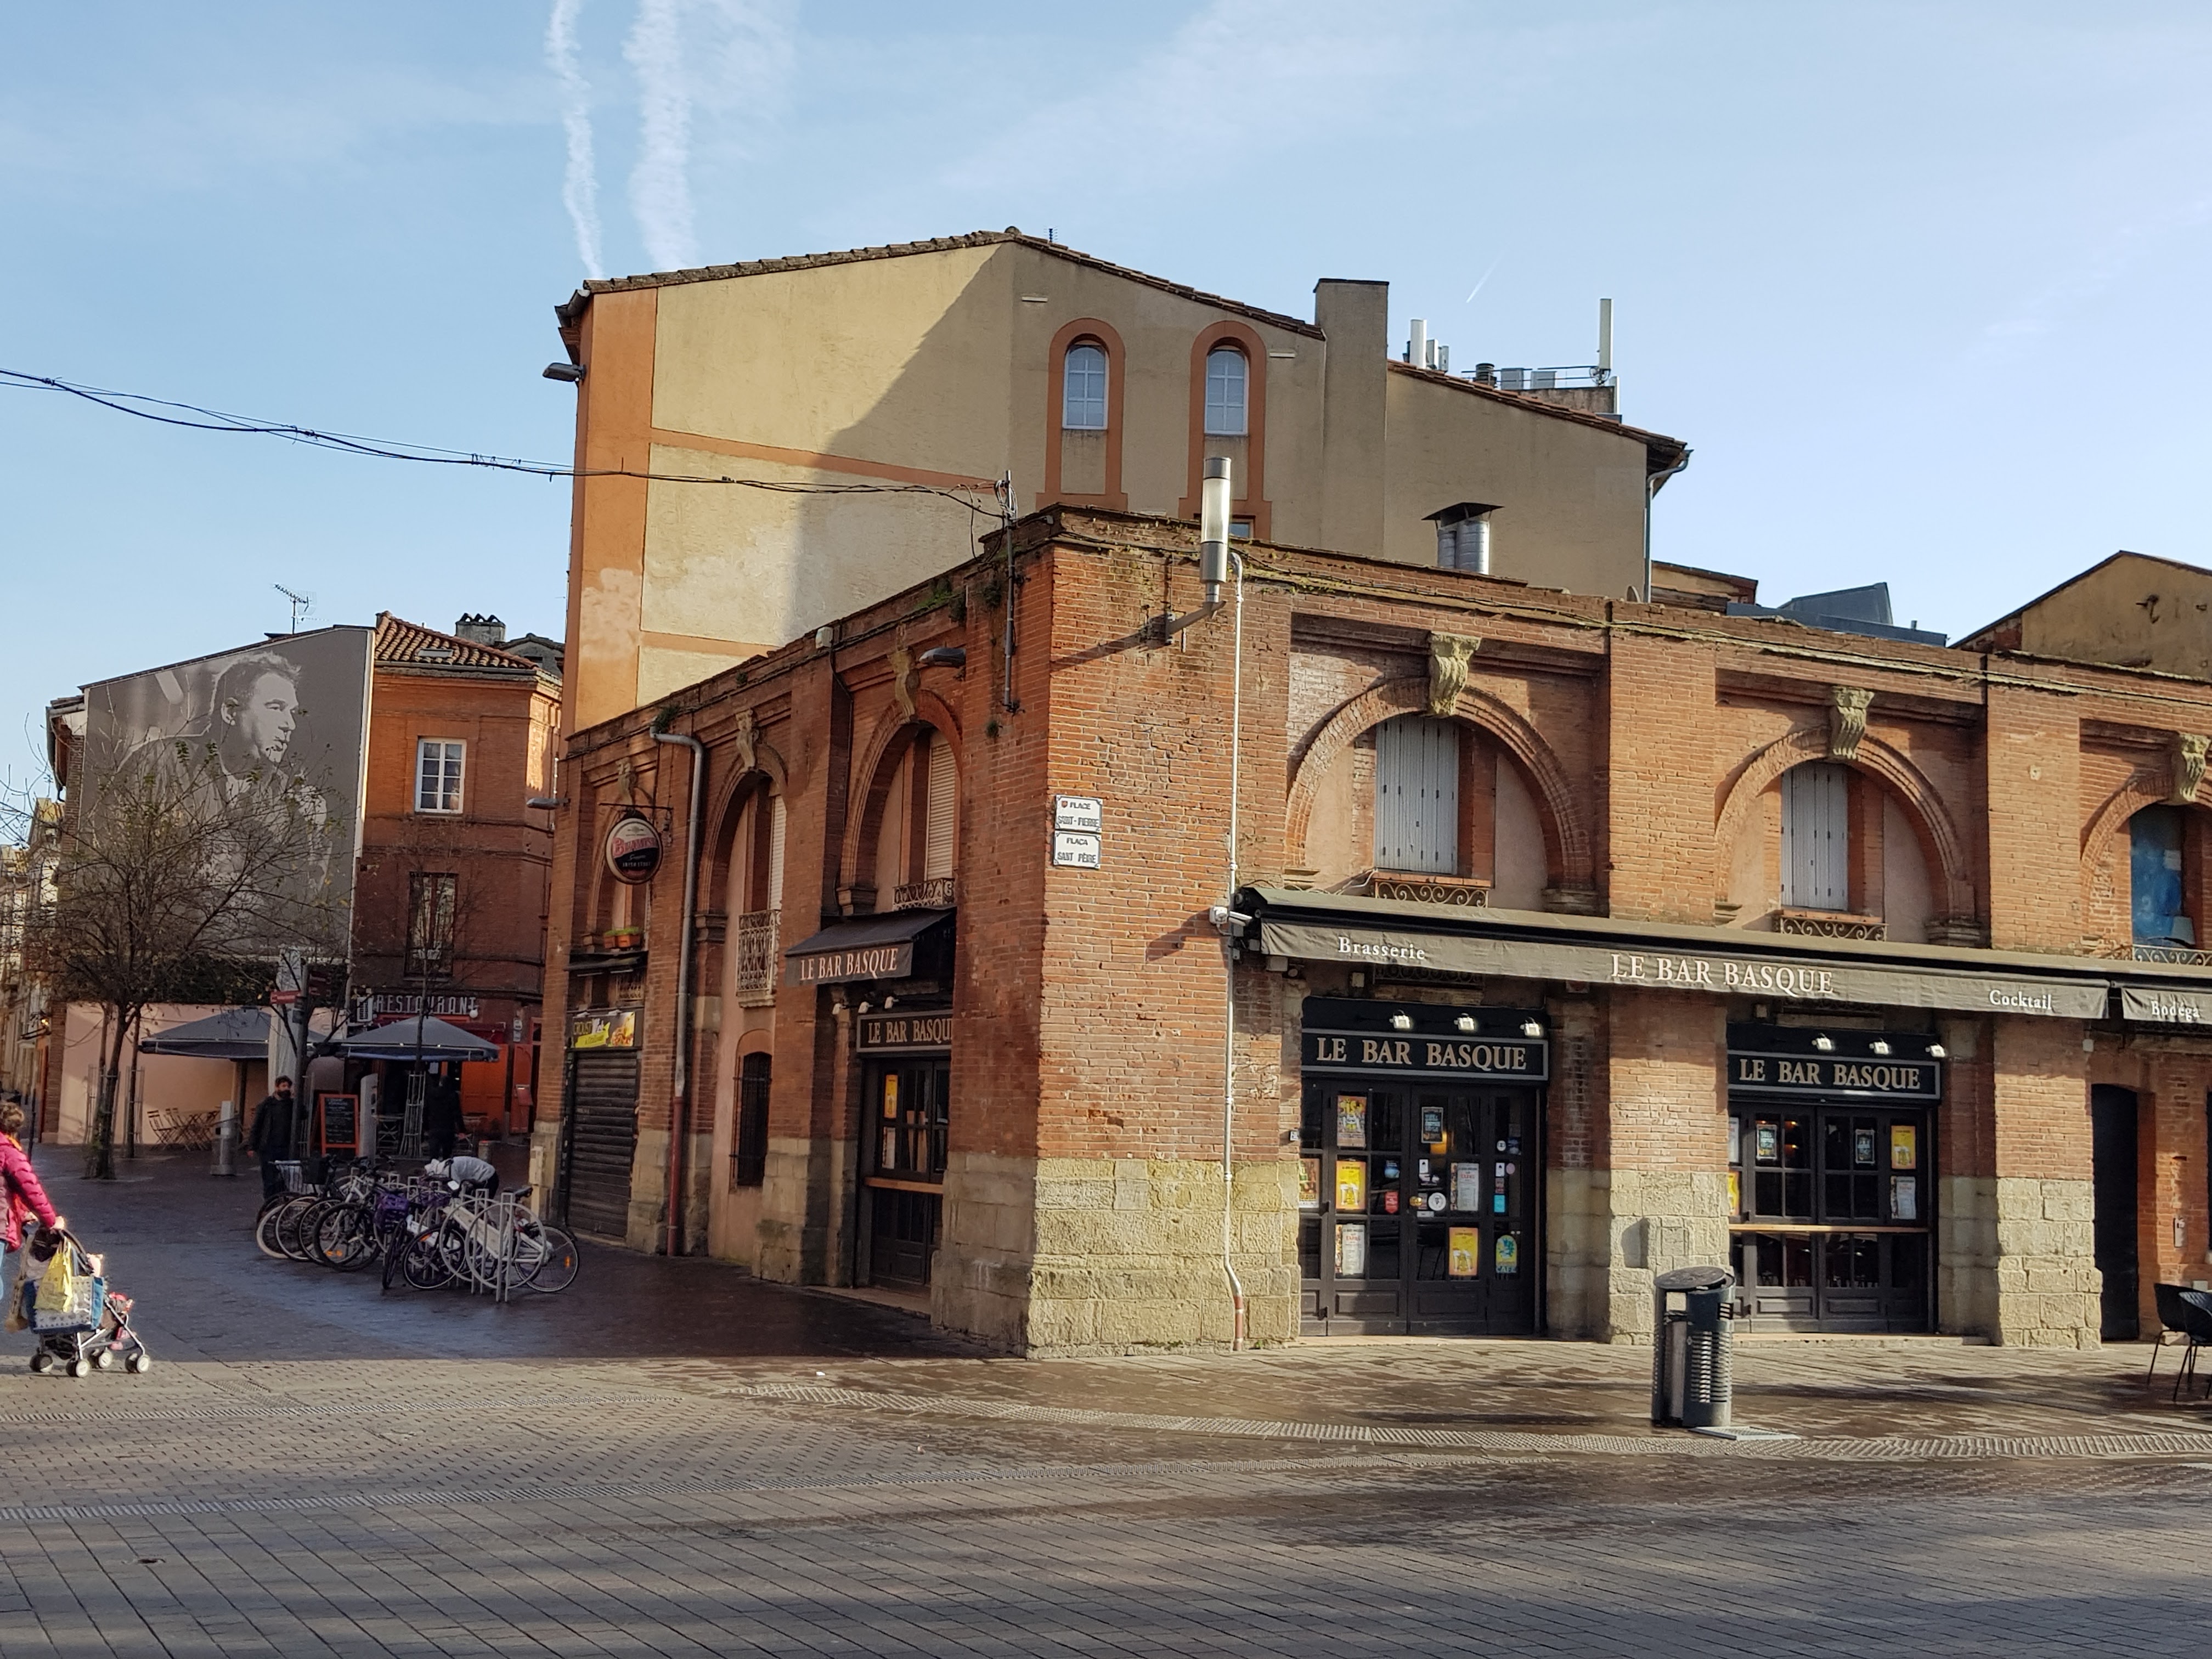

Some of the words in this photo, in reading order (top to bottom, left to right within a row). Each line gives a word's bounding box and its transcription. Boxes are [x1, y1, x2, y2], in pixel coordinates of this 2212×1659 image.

[1069, 802, 1091, 810] PLACE
[1338, 936, 1425, 960] Brasserie
[800, 958, 815, 980] LE
[818, 955, 842, 979] BAR
[845, 948, 899, 979] BASQUE
[1611, 953, 1645, 979] LE
[1656, 957, 1712, 984] BAR
[1723, 962, 1833, 997] BASQUE
[376, 994, 477, 1015] RESTAURANT
[1989, 989, 2053, 1011] Cocktail
[868, 1022, 881, 1043] LE
[886, 1020, 907, 1043] BAR
[913, 1018, 952, 1044] BASQU
[1317, 1037, 1347, 1062] LE
[1362, 1039, 1412, 1065] BAR
[1426, 1043, 1527, 1071] BASQUE
[1739, 1058, 1765, 1081] LE
[1778, 1061, 1821, 1085] BAR
[1833, 1064, 1920, 1091] BASQUE
